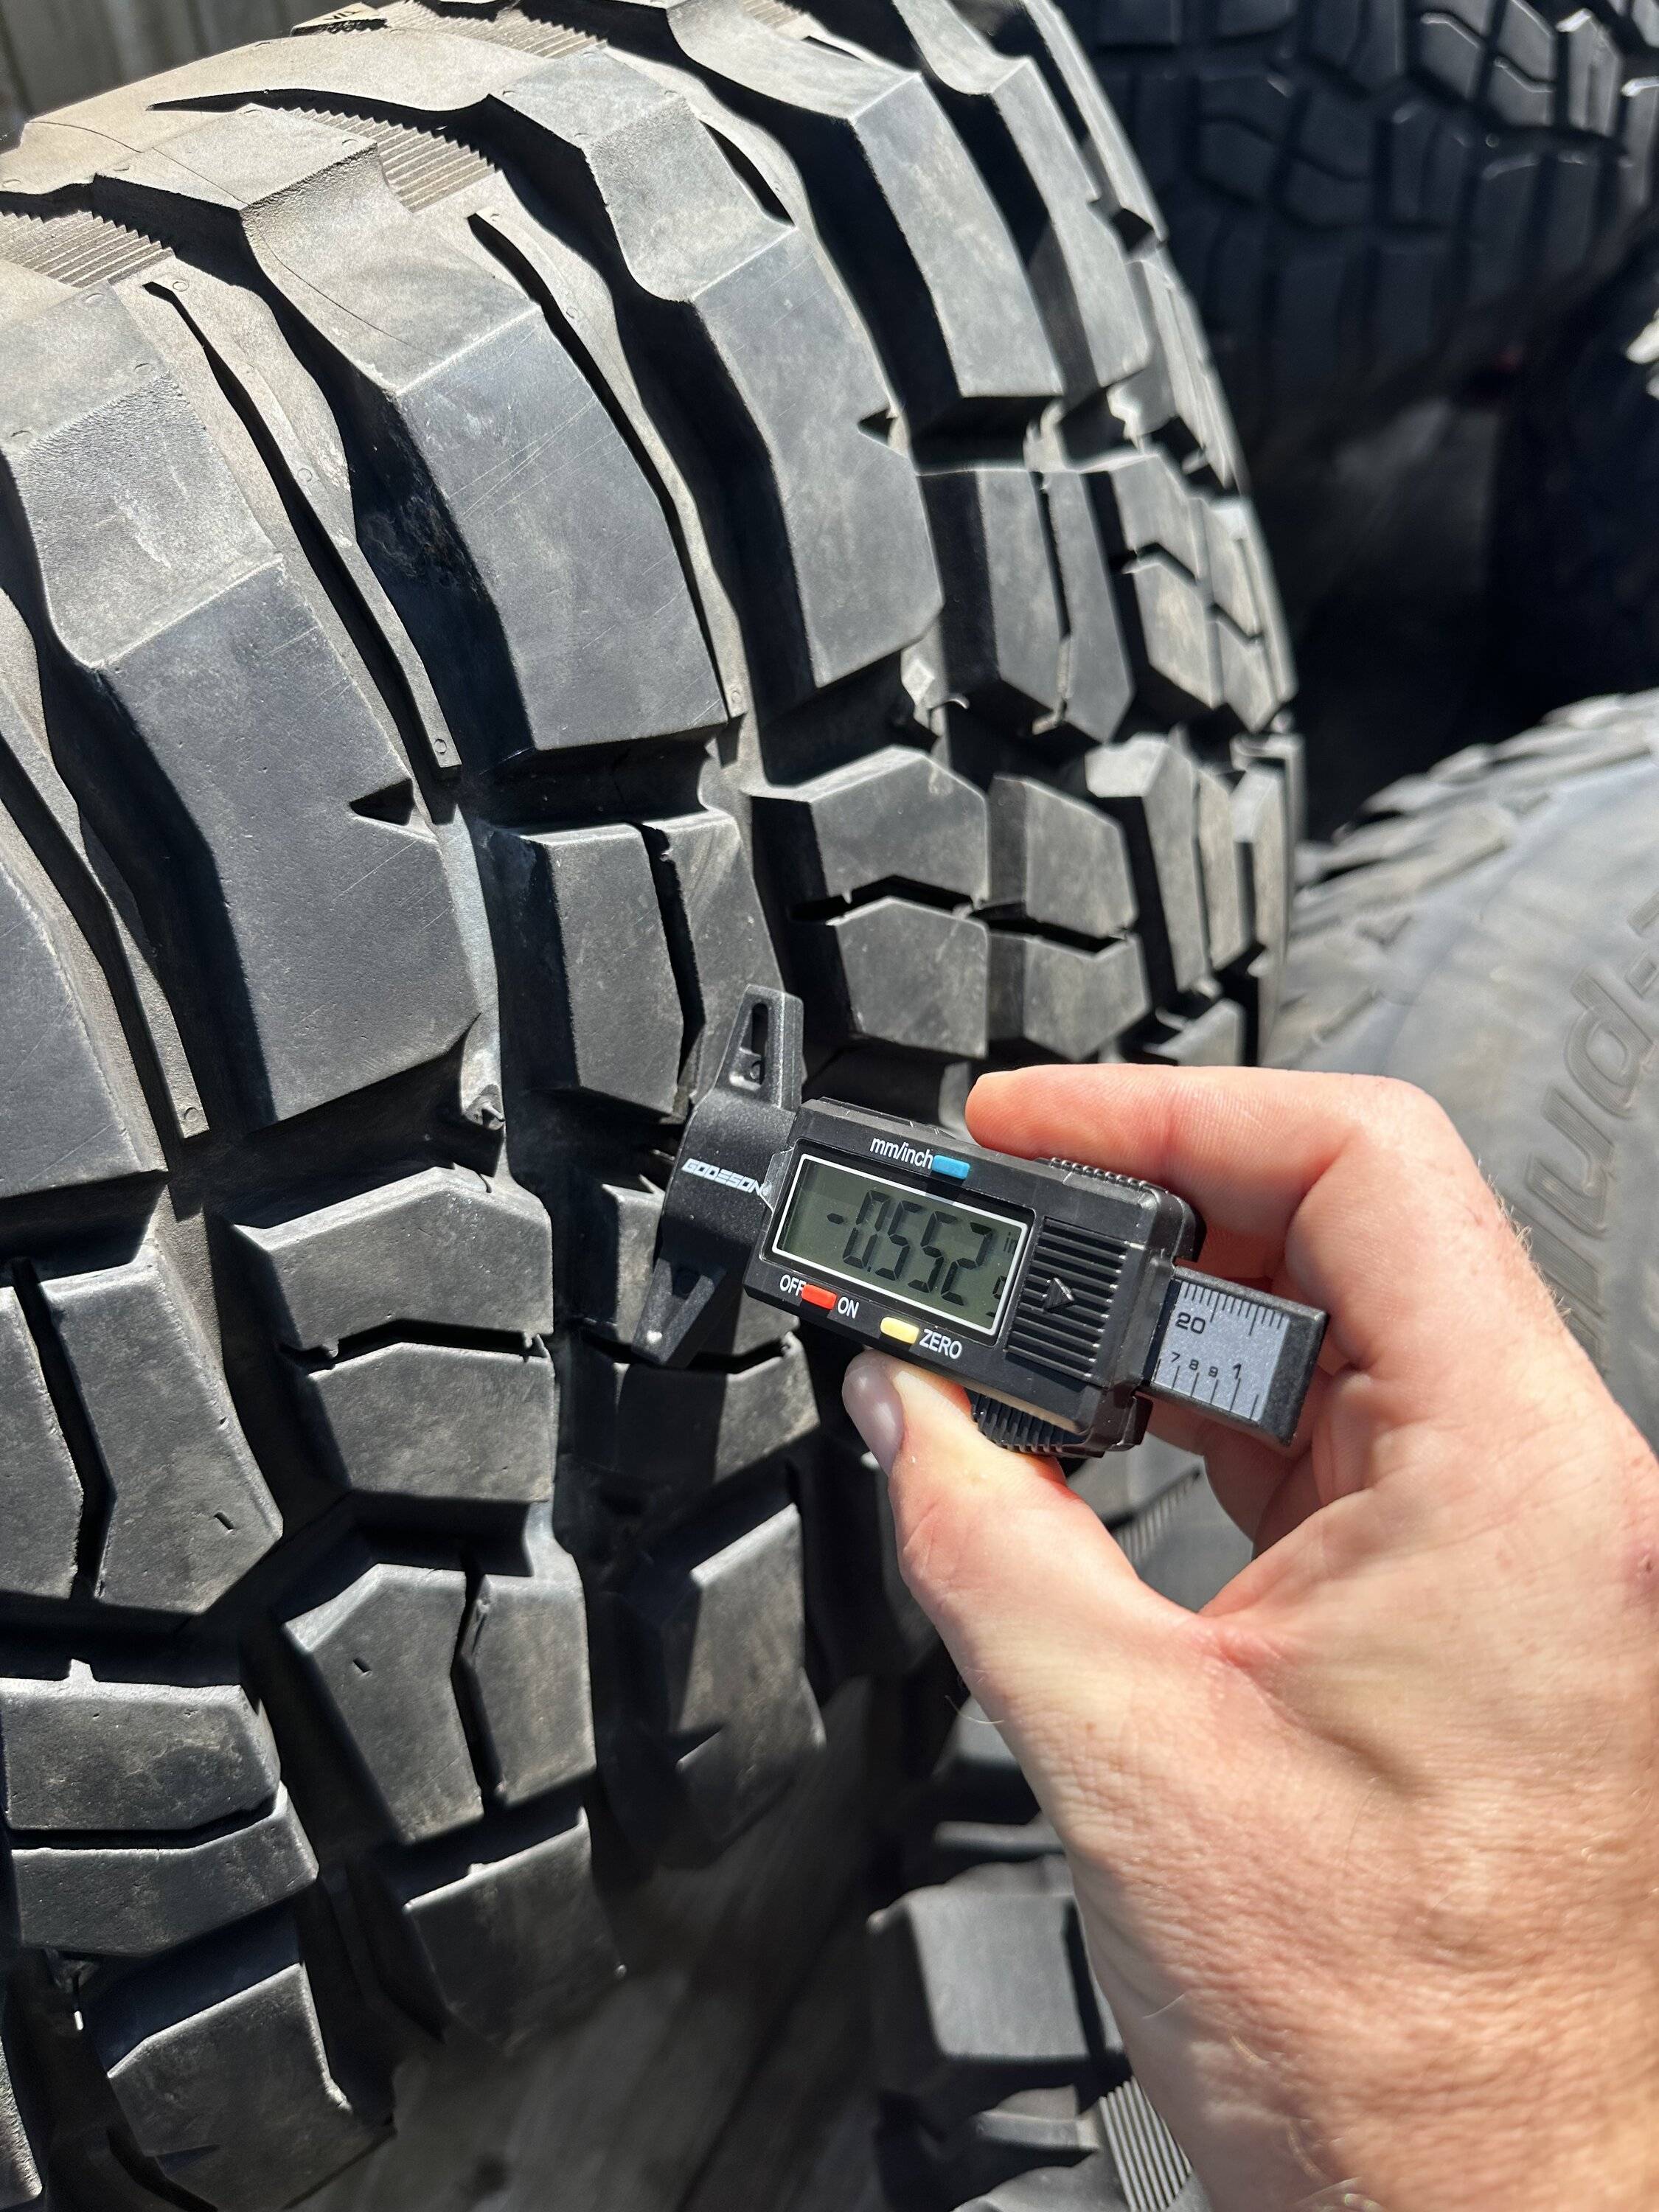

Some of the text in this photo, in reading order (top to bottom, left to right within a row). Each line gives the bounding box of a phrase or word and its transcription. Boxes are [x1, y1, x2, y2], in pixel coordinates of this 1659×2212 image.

[869, 1138, 934, 1170] mm/inch
[779, 1274, 807, 1296] OFF
[837, 1297, 860, 1319] ON
[1175, 1312, 1206, 1335] 20
[918, 1328, 963, 1360] ZERO
[1170, 1352, 1242, 1380] 7 8 9 1
